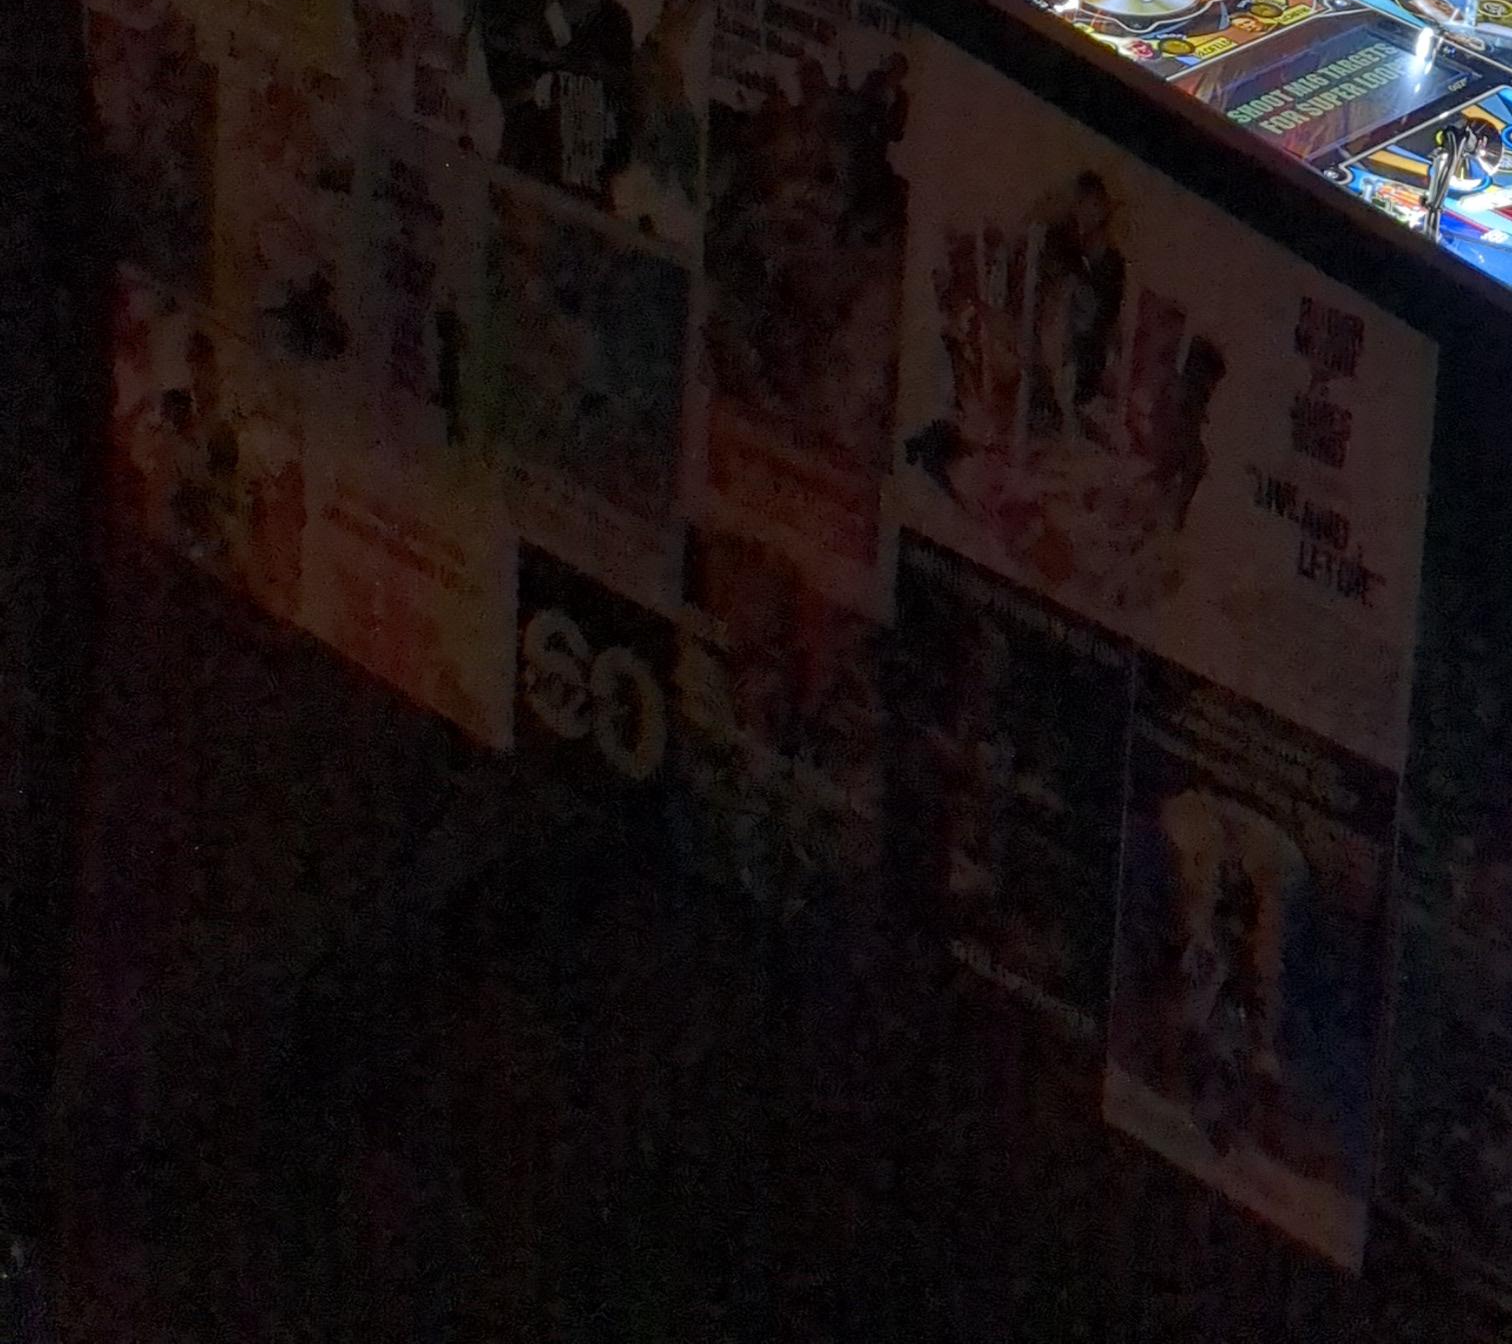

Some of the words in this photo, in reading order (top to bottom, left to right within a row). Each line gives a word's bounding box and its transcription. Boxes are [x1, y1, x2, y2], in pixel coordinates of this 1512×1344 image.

[1226, 88, 1294, 125] SHOOT
[1319, 41, 1400, 84] TARGETS
[1259, 106, 1312, 135] FOR
[1296, 82, 1369, 118] SUPER
